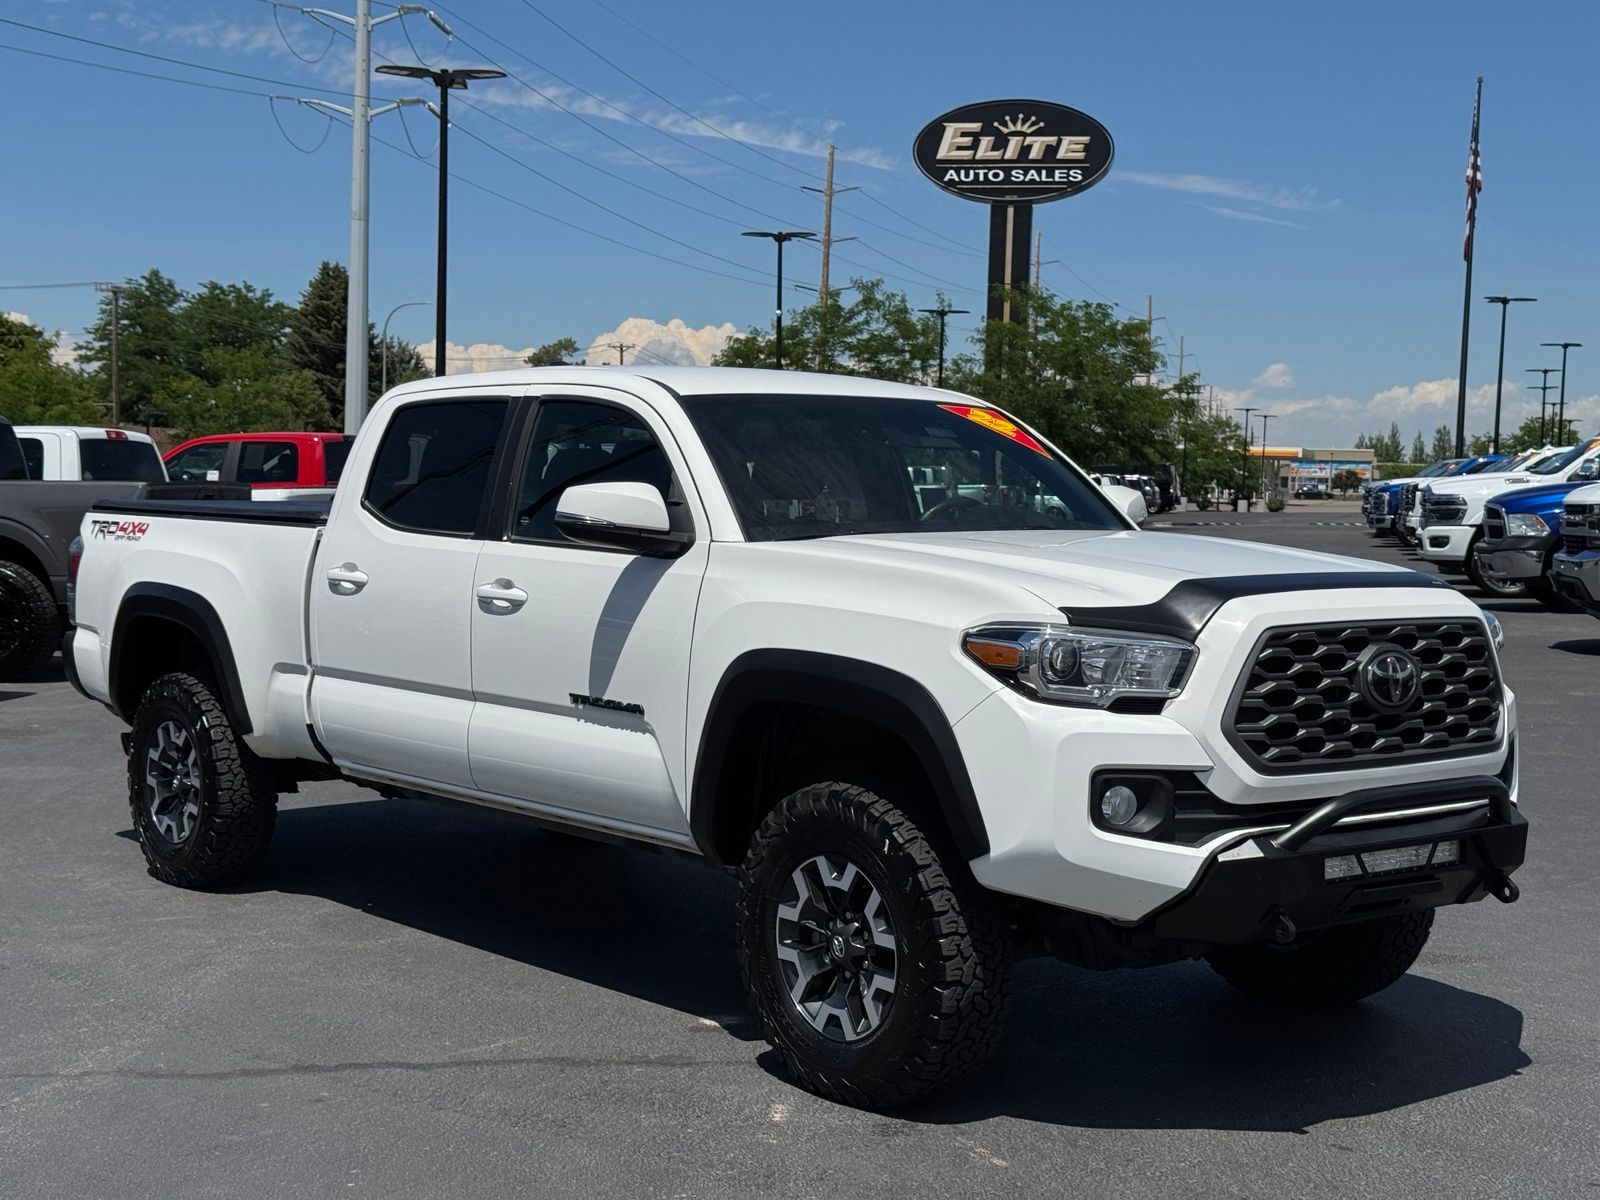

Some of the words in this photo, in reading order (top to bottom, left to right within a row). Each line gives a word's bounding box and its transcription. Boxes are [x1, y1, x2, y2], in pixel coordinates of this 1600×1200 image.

[936, 122, 1091, 160] ELITE
[943, 169, 1005, 182] AUTO
[1010, 169, 1083, 182] SALES
